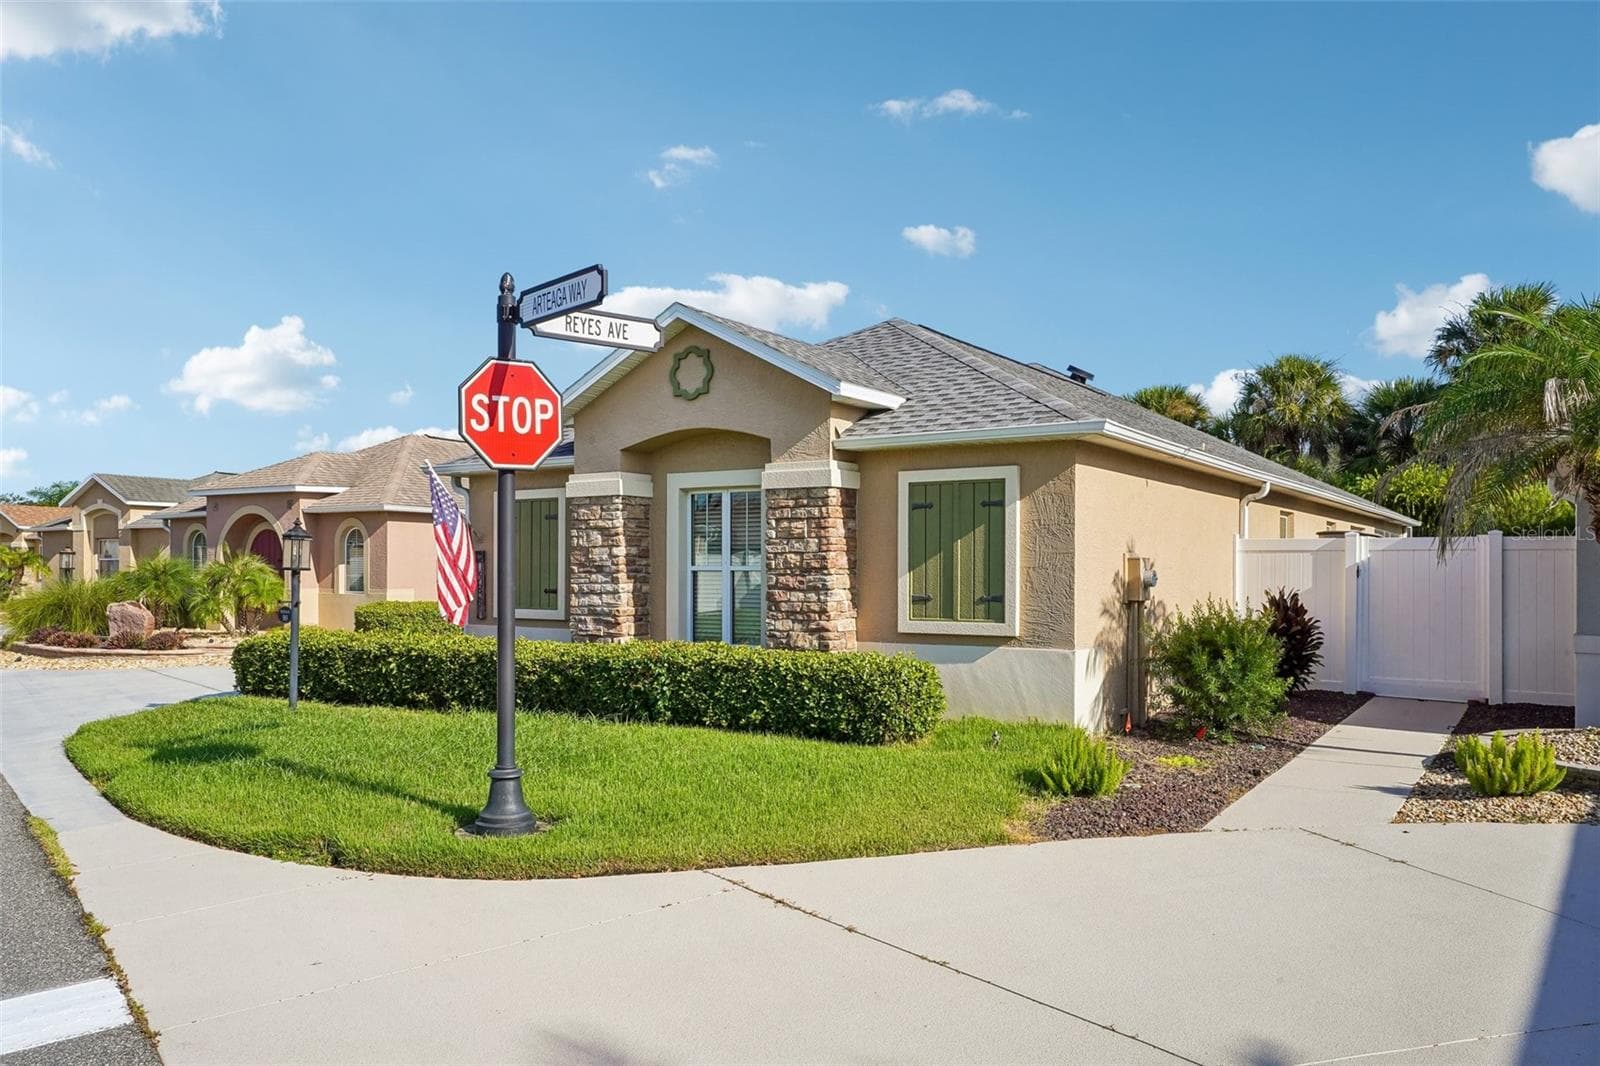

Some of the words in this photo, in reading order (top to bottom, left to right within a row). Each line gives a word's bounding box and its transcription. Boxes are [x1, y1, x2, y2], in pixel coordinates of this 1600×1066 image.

[532, 285, 567, 316] ARTEAGA
[568, 279, 588, 302] WAY
[565, 314, 602, 337] REYES
[607, 321, 629, 341] AVE
[469, 392, 555, 436] STOP
